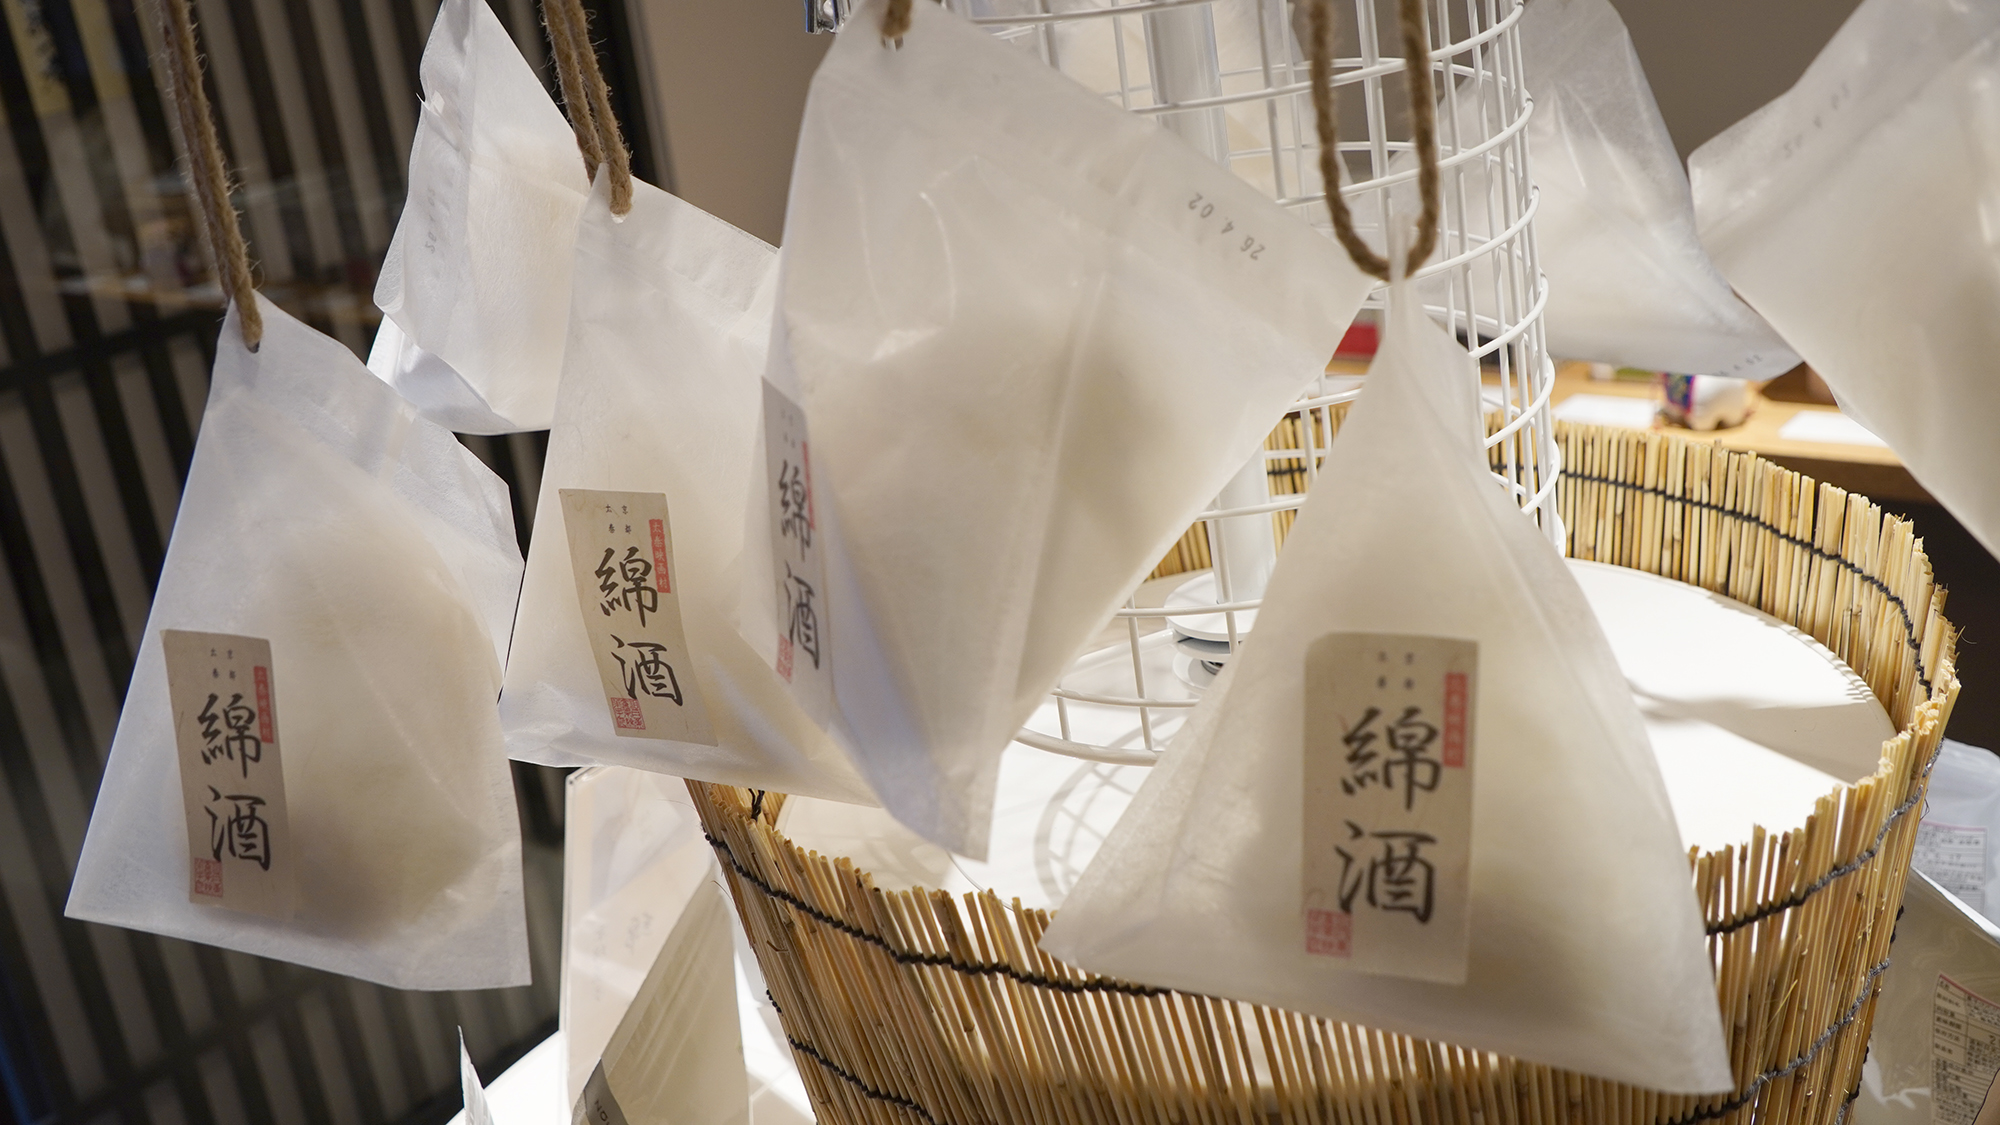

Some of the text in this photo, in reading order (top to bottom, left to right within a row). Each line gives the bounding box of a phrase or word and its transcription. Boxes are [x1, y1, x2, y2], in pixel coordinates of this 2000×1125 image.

[594, 545, 683, 707] 綿酒
[779, 459, 820, 670] 綿酒
[197, 692, 271, 872] 綿酒
[1334, 705, 1442, 925] 綿酒
